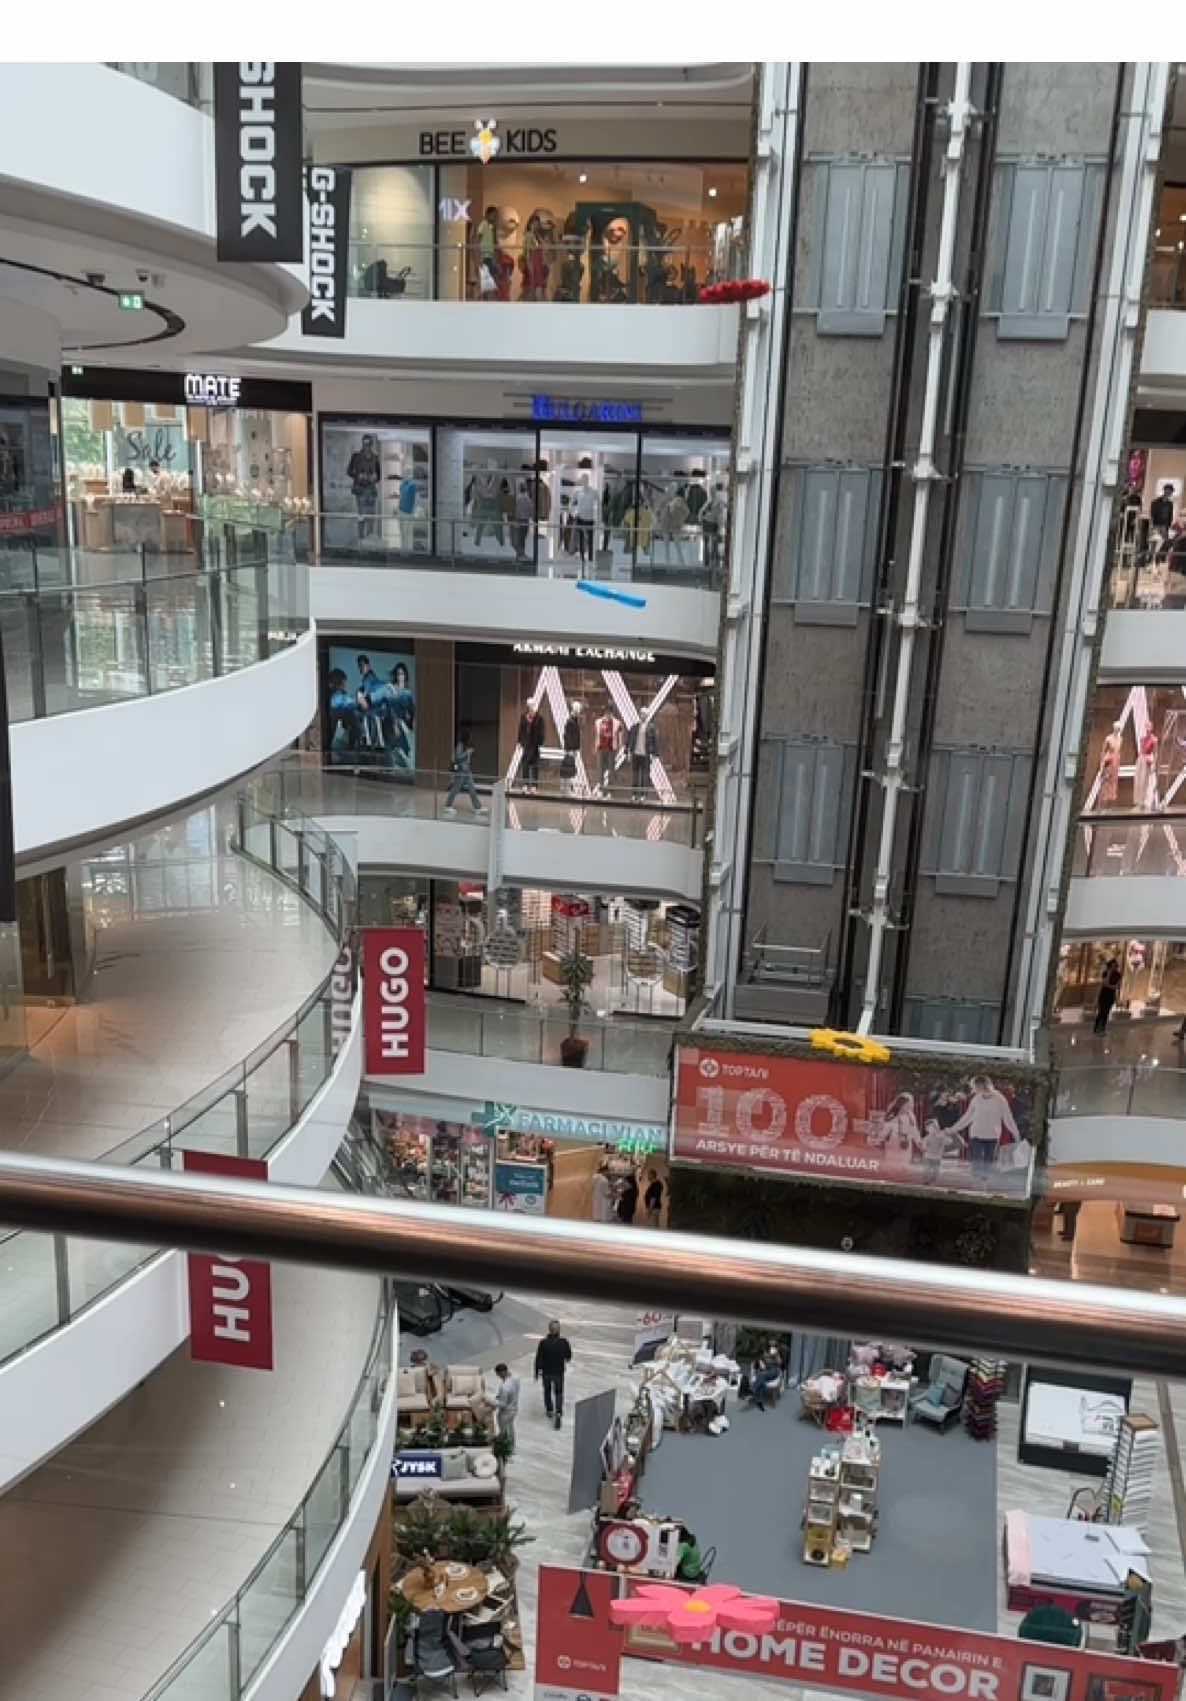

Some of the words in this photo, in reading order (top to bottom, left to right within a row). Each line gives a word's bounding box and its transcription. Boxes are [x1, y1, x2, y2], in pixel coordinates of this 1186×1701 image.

[238, 62, 278, 240] SHOCK
[418, 131, 467, 156] BEE
[505, 128, 558, 154] KIDS
[310, 166, 336, 323] G-SHOCK
[184, 374, 241, 397] MATE
[380, 947, 409, 1058] HUGO
[696, 1138, 747, 1156] ARSYE
[804, 1152, 880, 1171] NDALUAR
[211, 1253, 250, 1342] HU
[401, 1461, 436, 1473] JYSK
[838, 1648, 1000, 1701] DECOR
[913, 1643, 989, 1668] PANAIRIN
